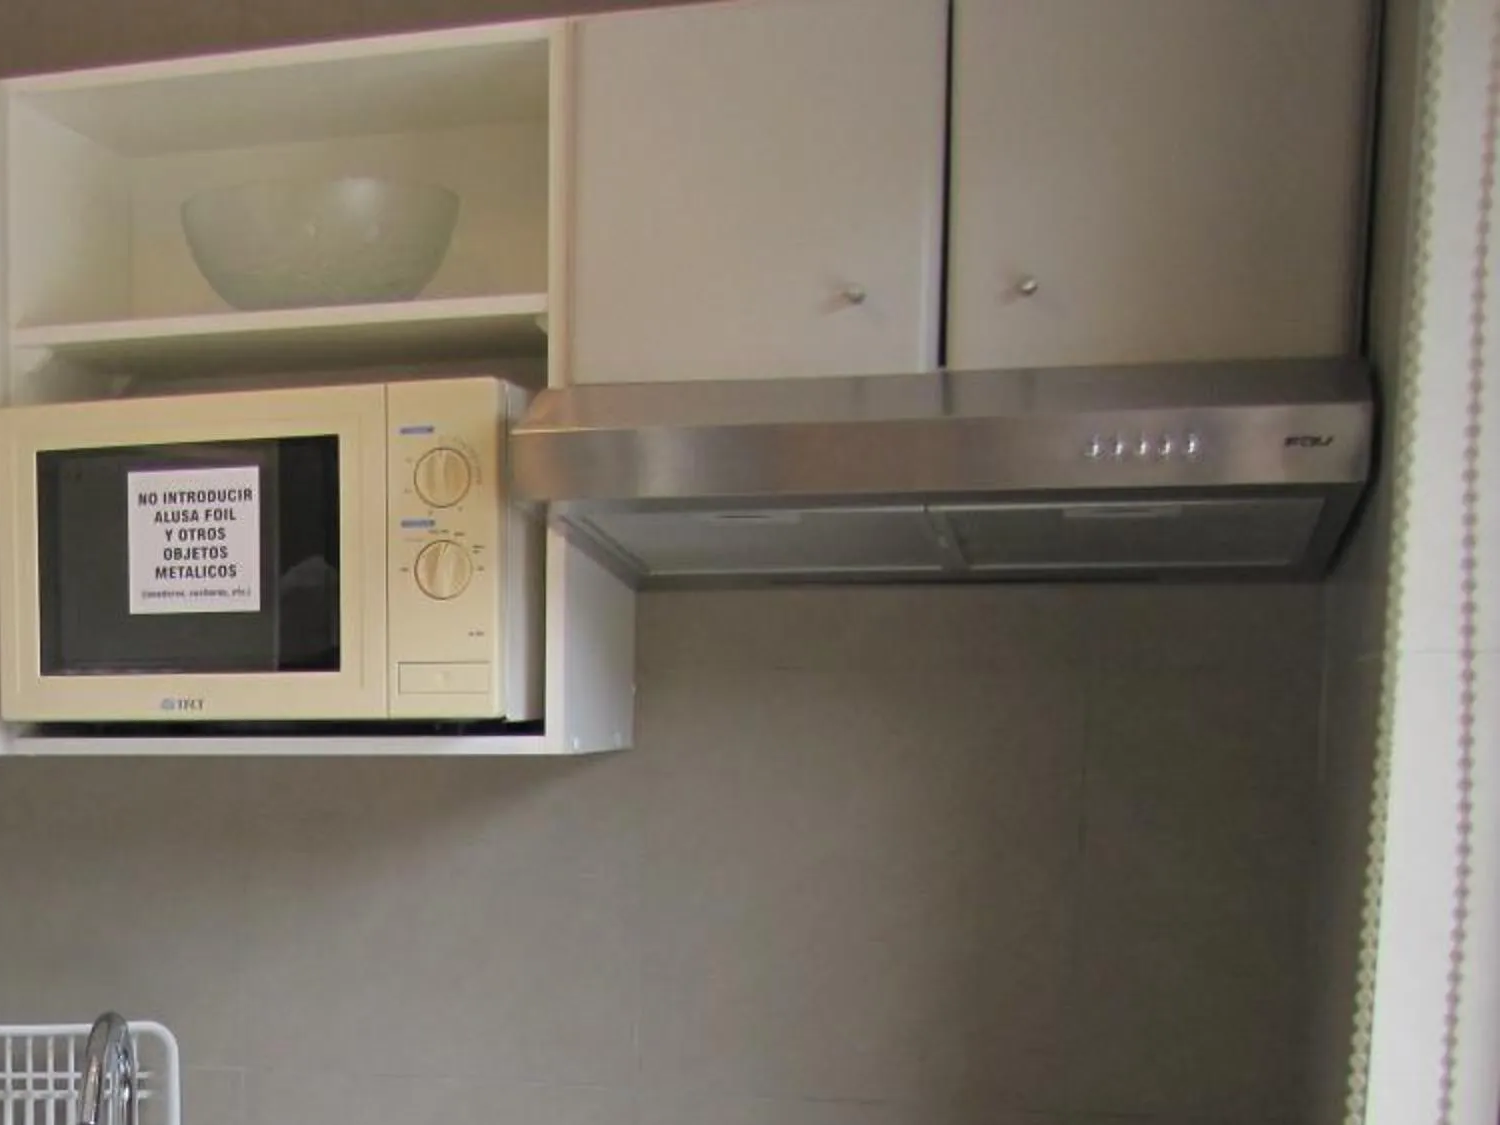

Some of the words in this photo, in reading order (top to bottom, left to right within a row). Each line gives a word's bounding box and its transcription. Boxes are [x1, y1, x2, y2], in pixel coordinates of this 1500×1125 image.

[138, 492, 157, 506] NO
[163, 488, 253, 505] INTRODUCIR
[154, 509, 199, 524] ALUSA
[205, 508, 237, 522] FOIL
[165, 530, 173, 542] Y
[178, 527, 226, 541] OTROS
[163, 546, 229, 561] OBJETOS
[155, 564, 238, 580] METALICOS
